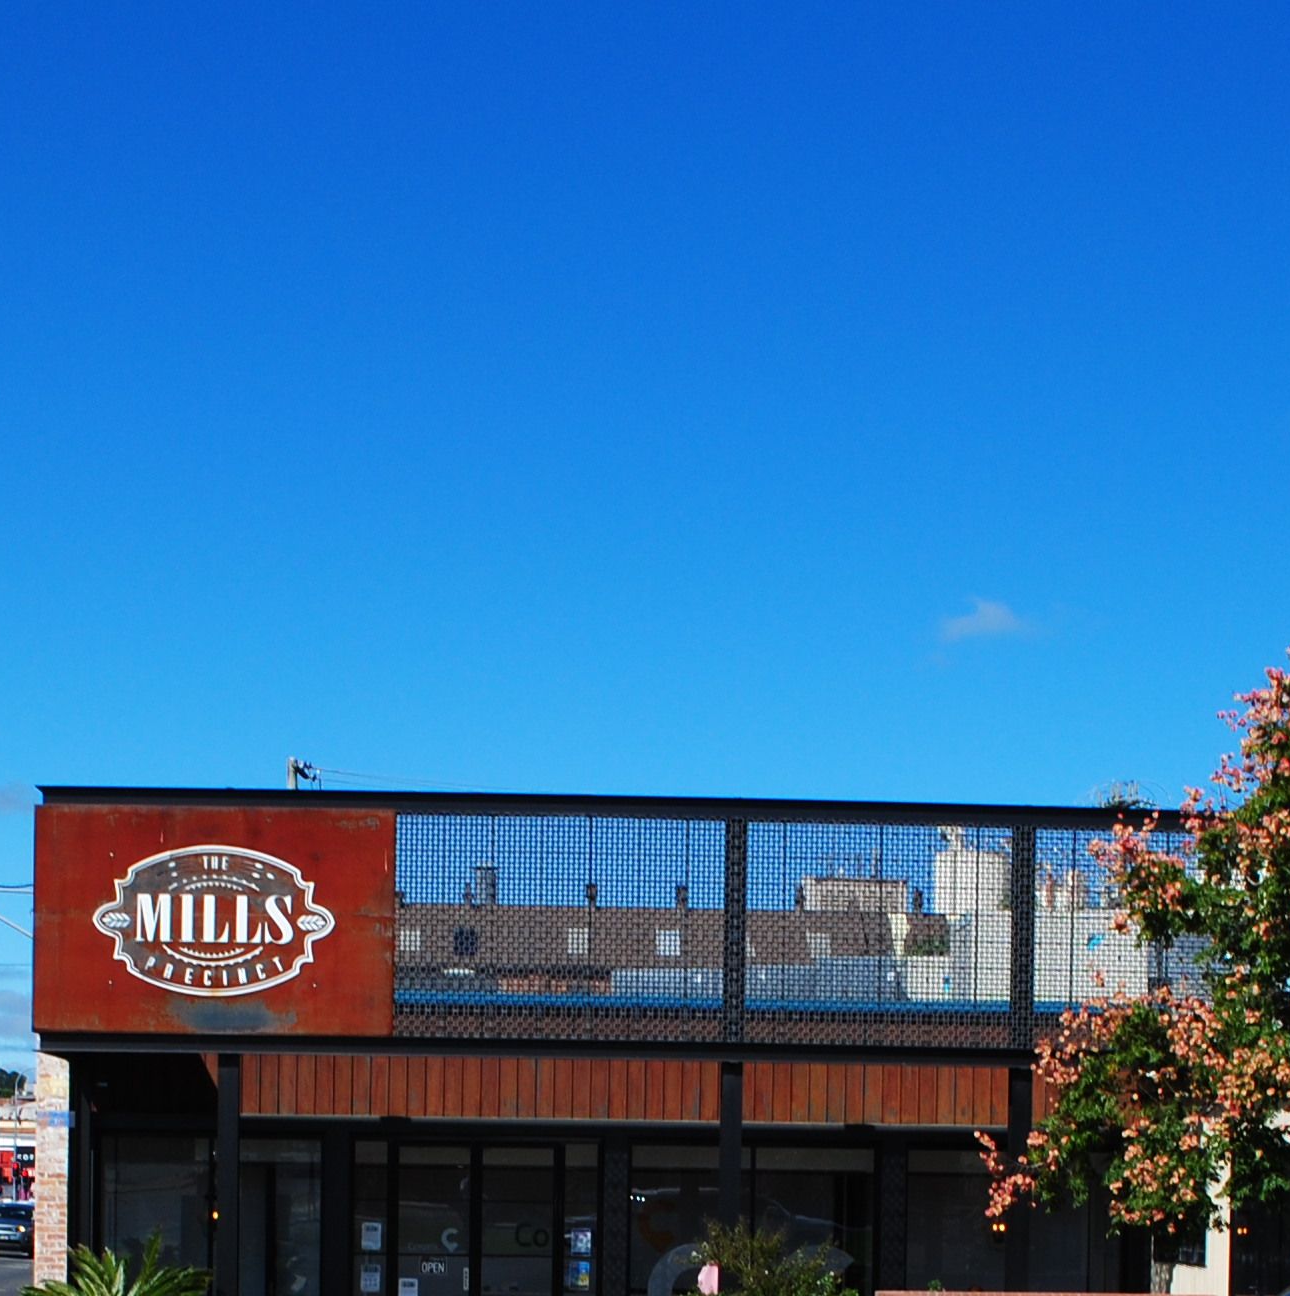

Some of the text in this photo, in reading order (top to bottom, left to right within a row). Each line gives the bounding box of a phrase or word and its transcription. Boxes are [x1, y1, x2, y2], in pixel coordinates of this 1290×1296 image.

[202, 855, 230, 872] THE
[134, 892, 294, 946] MILLS
[143, 955, 285, 987] PRECINCT
[421, 1260, 445, 1274] OPEN
